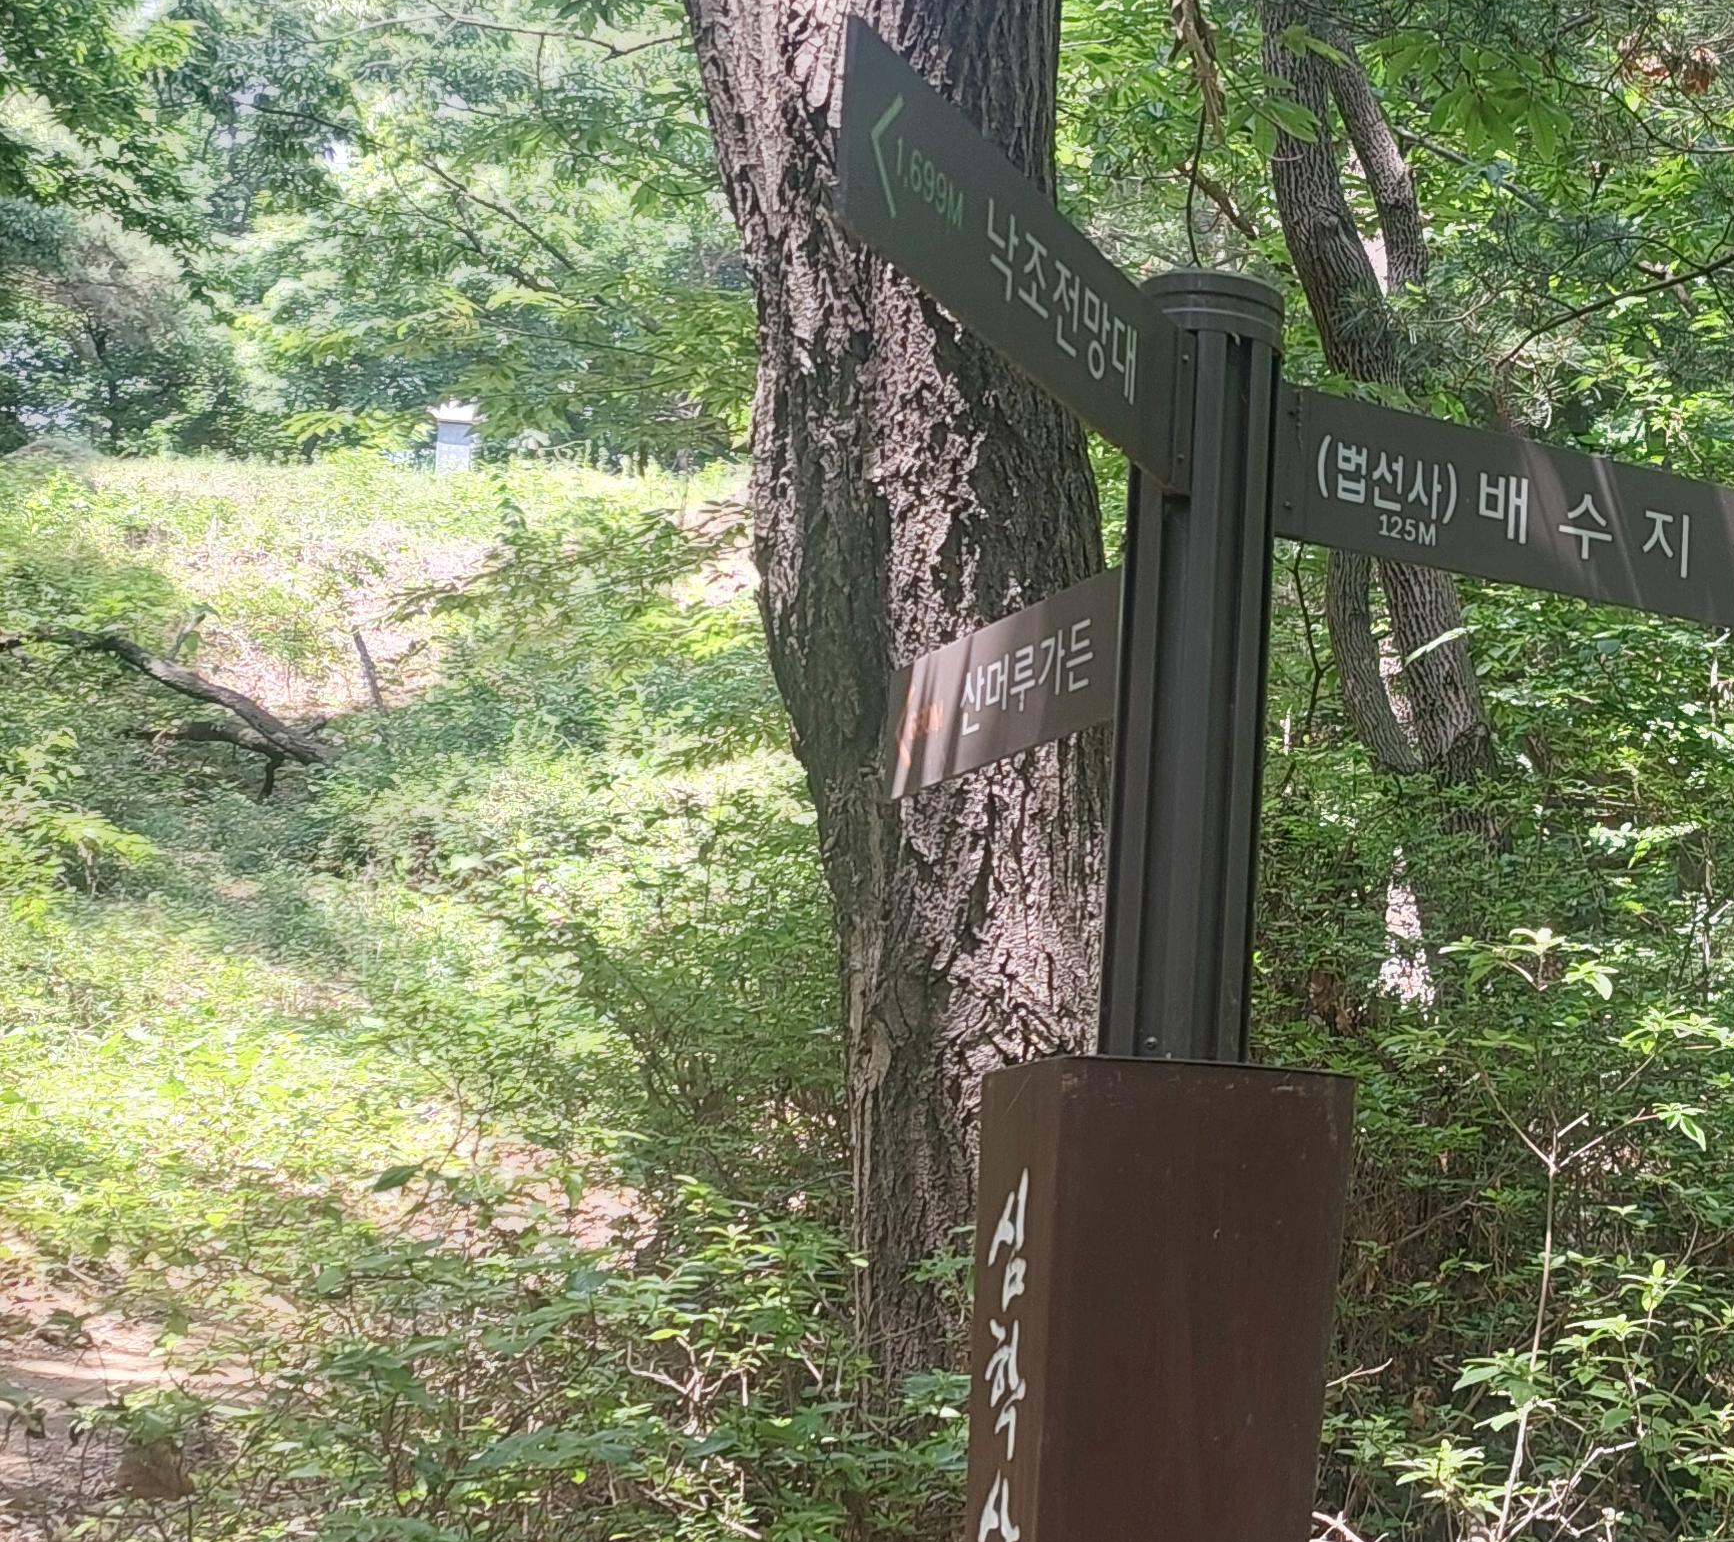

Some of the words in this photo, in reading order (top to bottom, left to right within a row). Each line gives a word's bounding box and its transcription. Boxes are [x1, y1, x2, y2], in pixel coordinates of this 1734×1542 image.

[986, 197, 1138, 406] 낙조전망대
[1316, 433, 1458, 525] (법선사)
[1378, 513, 1437, 548] 125M
[959, 617, 1094, 736] 산머루가든
